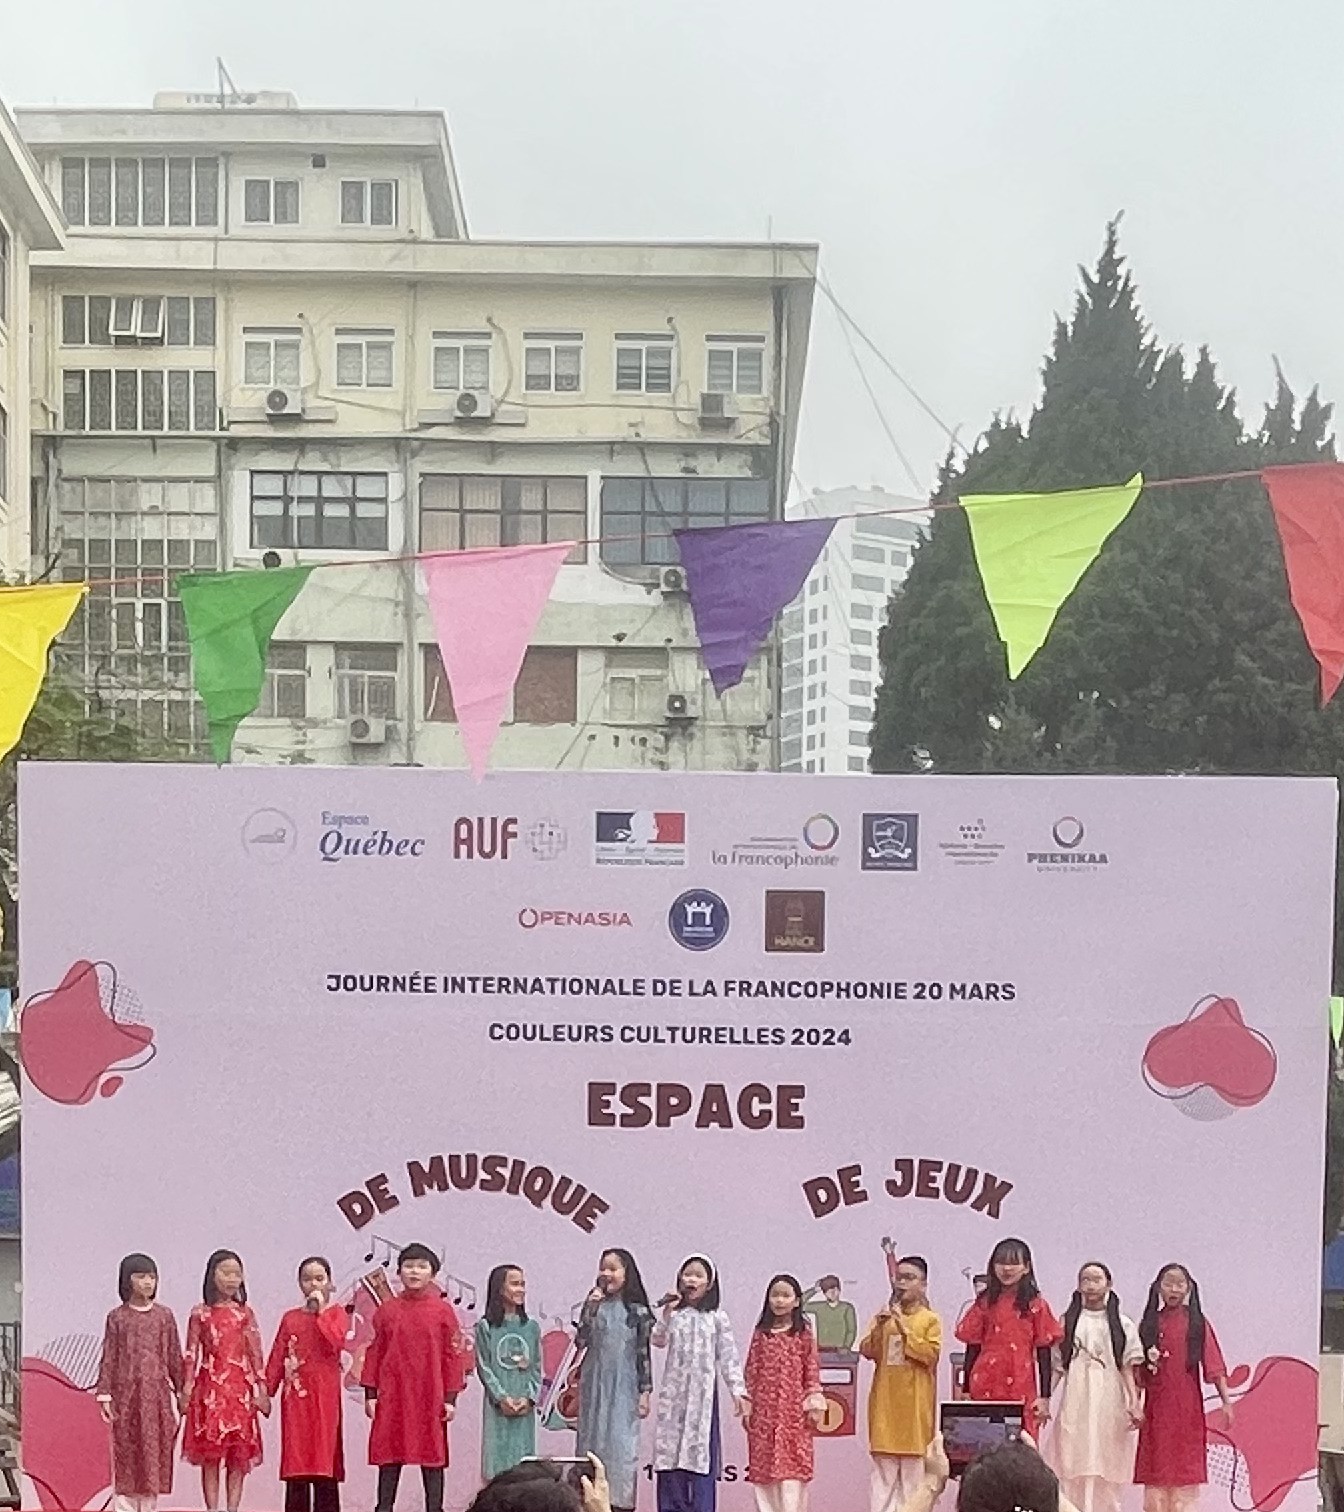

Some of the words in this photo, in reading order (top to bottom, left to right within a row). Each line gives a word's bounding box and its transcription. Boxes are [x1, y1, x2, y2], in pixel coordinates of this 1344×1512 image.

[319, 829, 425, 862] Québec
[453, 817, 517, 859] AUF
[327, 972, 437, 993] JOURNÉE
[442, 975, 646, 996] INTERNATIONALE
[652, 979, 682, 997] DE
[688, 979, 717, 997] LA
[724, 980, 908, 999] FRANCOPHONIE
[913, 982, 943, 1000] 20
[949, 982, 1016, 1001] MARS
[489, 1022, 614, 1042] COULEURS
[620, 1026, 786, 1045] CULTURELLES
[791, 1028, 852, 1046] 2024
[587, 1081, 805, 1129] ESPACE
[336, 1173, 400, 1230] DE
[406, 1153, 610, 1233] MUSIQUE
[802, 1164, 869, 1219] DE
[884, 1158, 1014, 1219] JEUX
